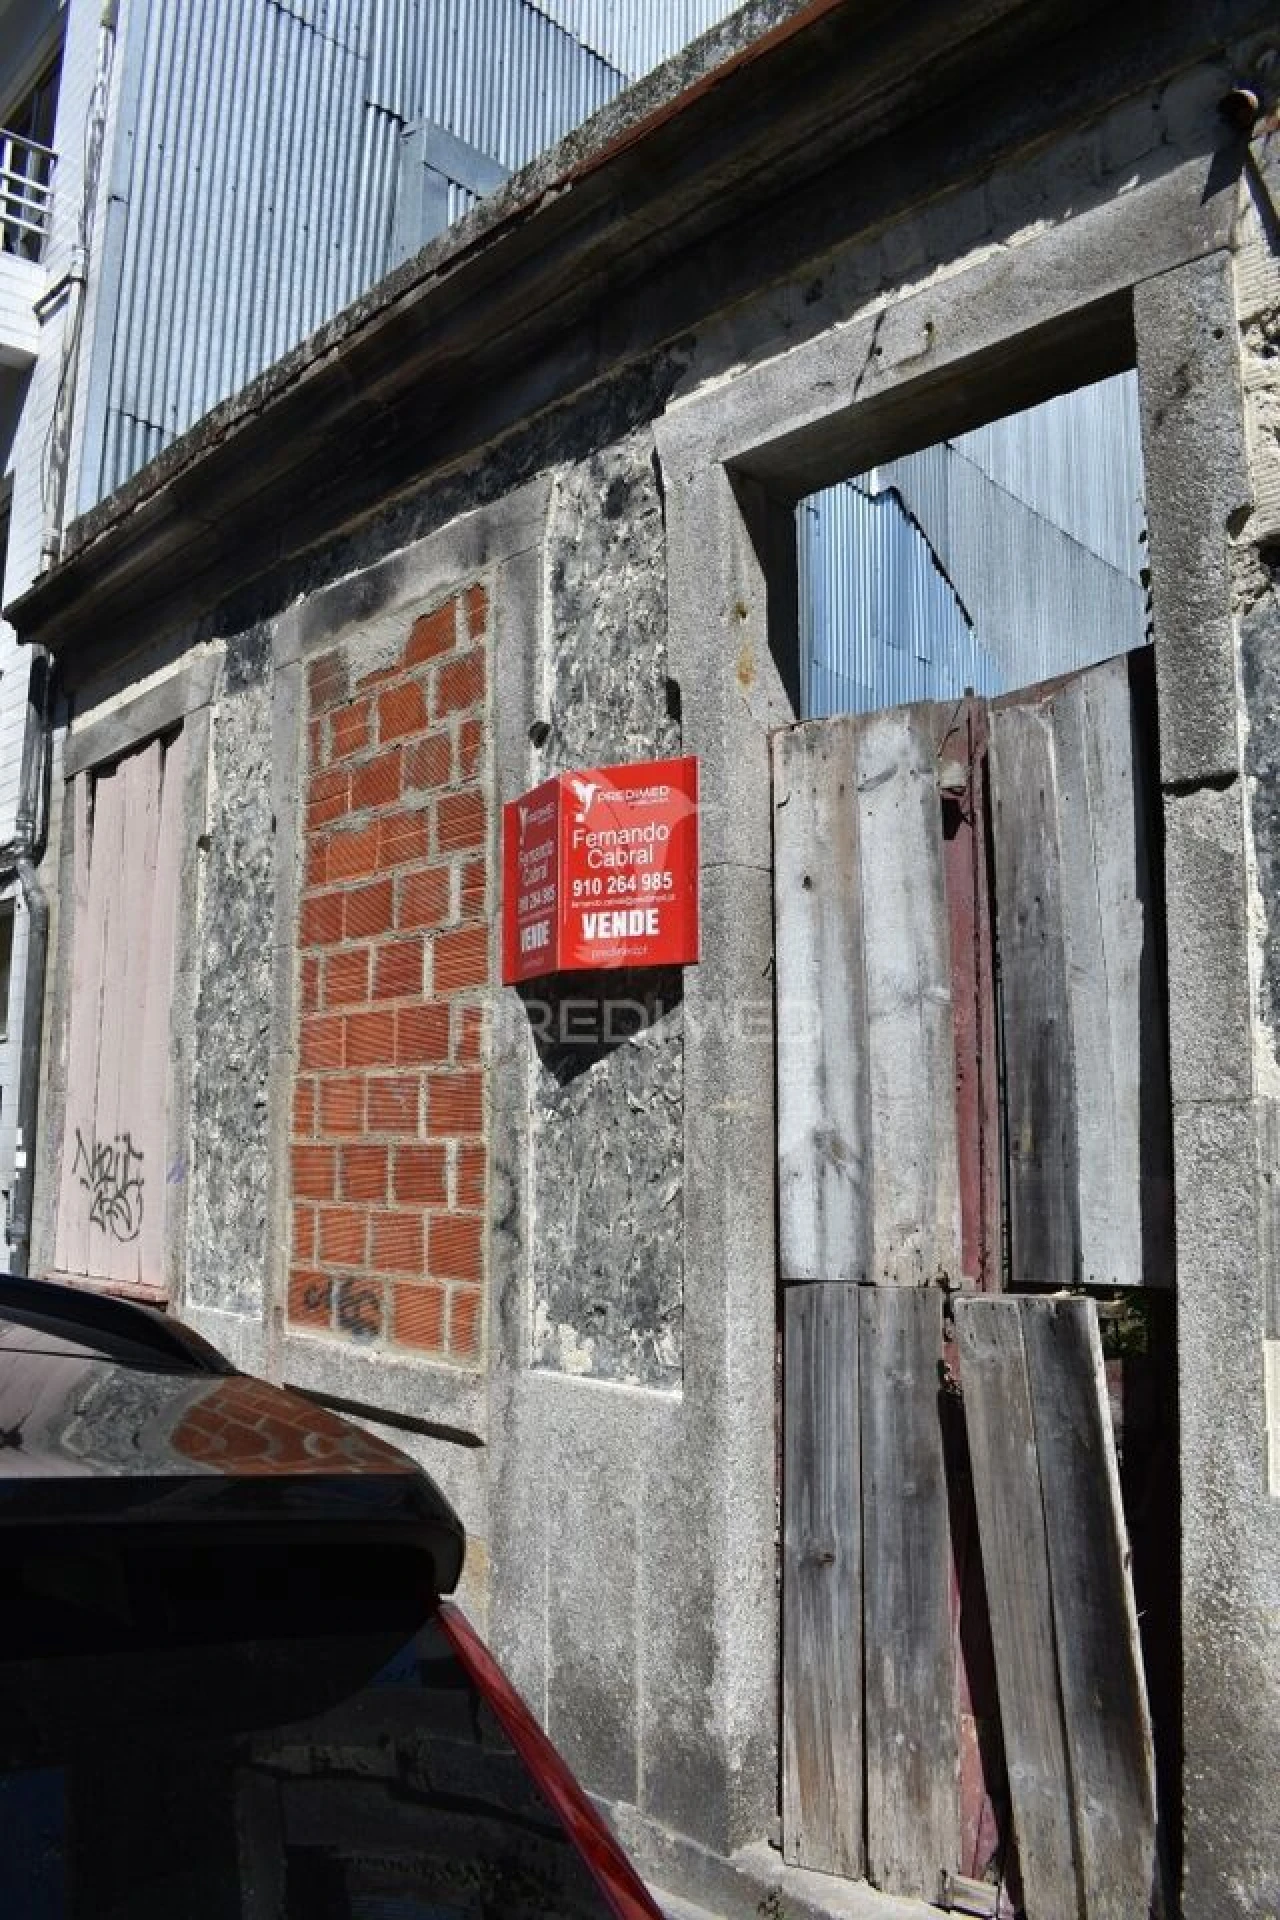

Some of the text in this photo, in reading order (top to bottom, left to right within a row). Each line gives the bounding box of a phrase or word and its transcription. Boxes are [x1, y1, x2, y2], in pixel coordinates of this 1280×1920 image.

[573, 821, 670, 849] Fernando
[587, 844, 653, 869] Cabral
[572, 871, 673, 897] 910 264 985
[581, 909, 660, 940] VENDE
